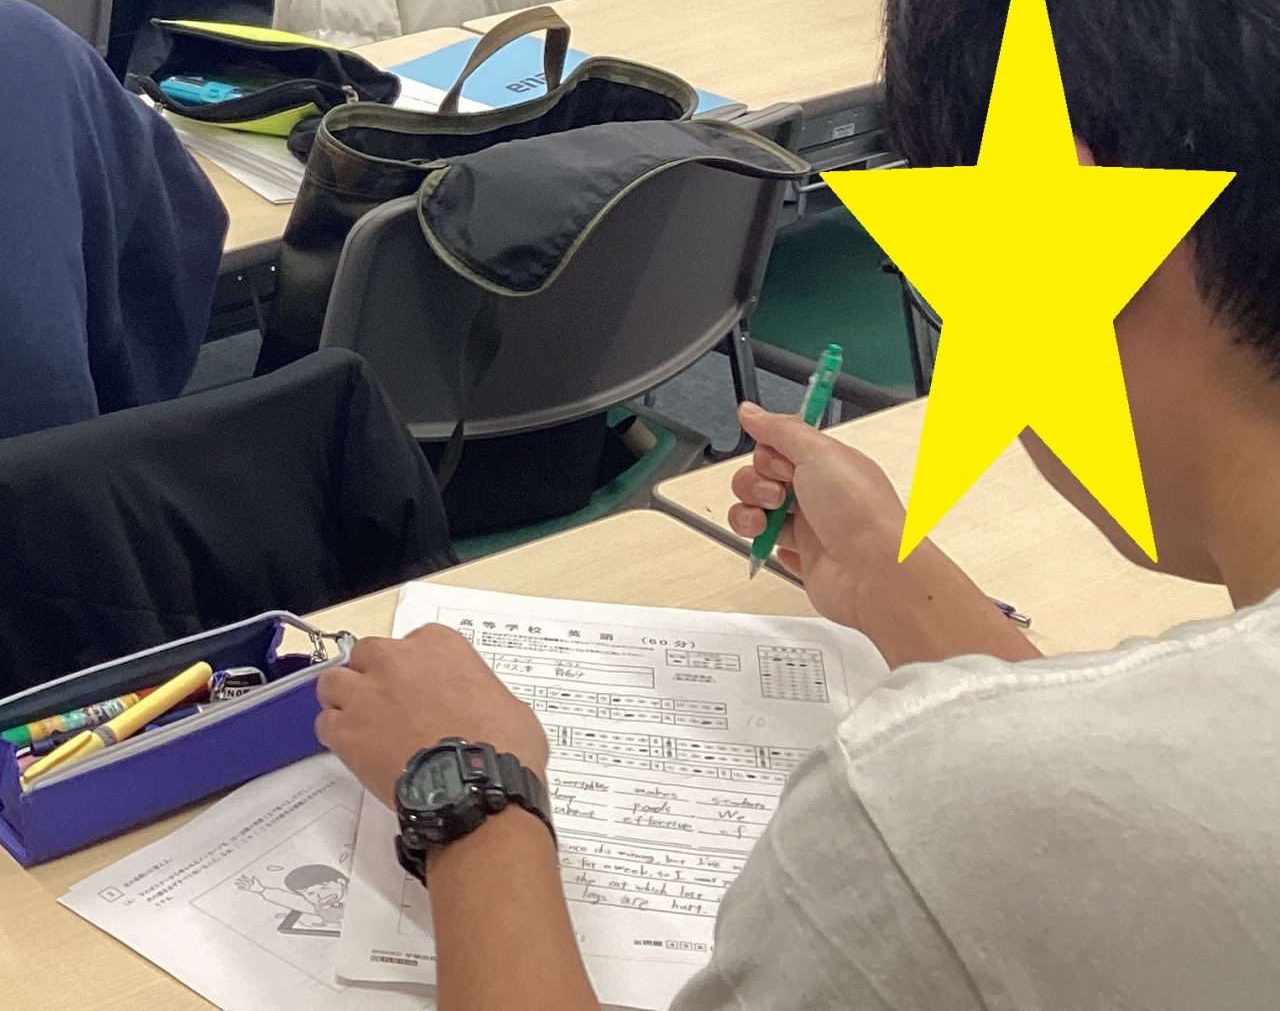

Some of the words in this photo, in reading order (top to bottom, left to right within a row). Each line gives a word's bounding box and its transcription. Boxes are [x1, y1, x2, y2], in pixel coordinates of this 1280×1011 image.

[459, 617, 543, 635] 高等学校
[567, 628, 615, 643] 英語
